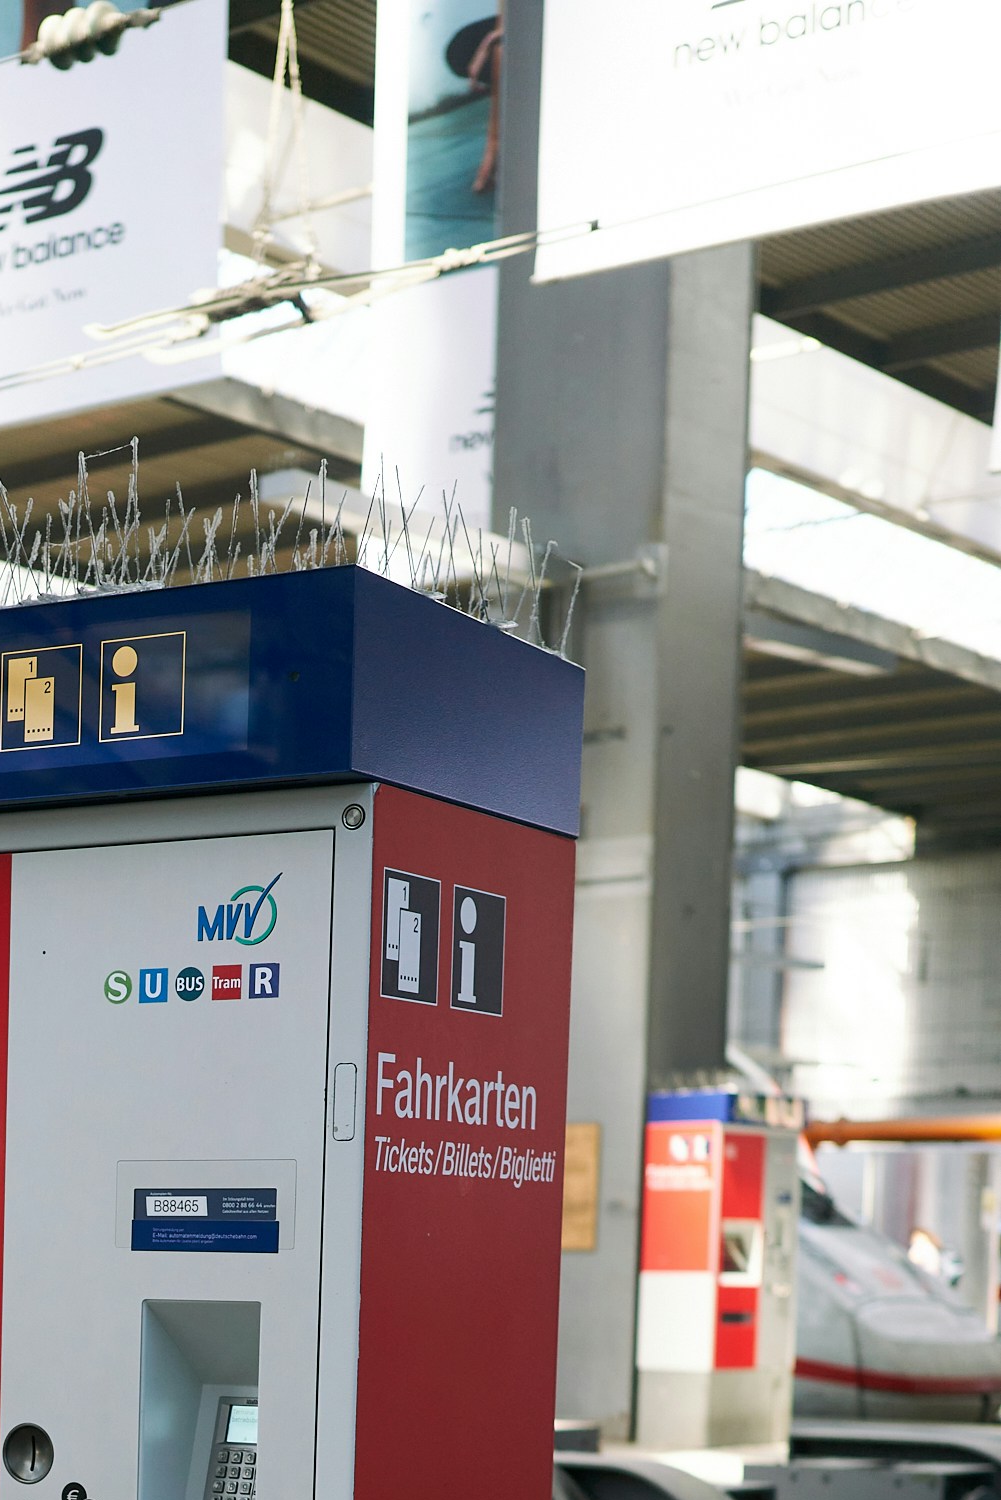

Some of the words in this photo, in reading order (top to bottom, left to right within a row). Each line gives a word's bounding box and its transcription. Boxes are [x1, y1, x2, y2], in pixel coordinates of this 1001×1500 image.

[673, 27, 748, 68] new
[12, 222, 125, 269] balance
[107, 972, 128, 1002] S
[144, 972, 163, 998] U
[176, 977, 204, 992] BUS
[213, 976, 241, 989] Tram
[254, 967, 273, 995] R
[376, 1051, 537, 1131] Fahrkarten
[374, 1136, 557, 1189] Tickets/Billets/Biglietti
[154, 1199, 199, 1213] B88465
